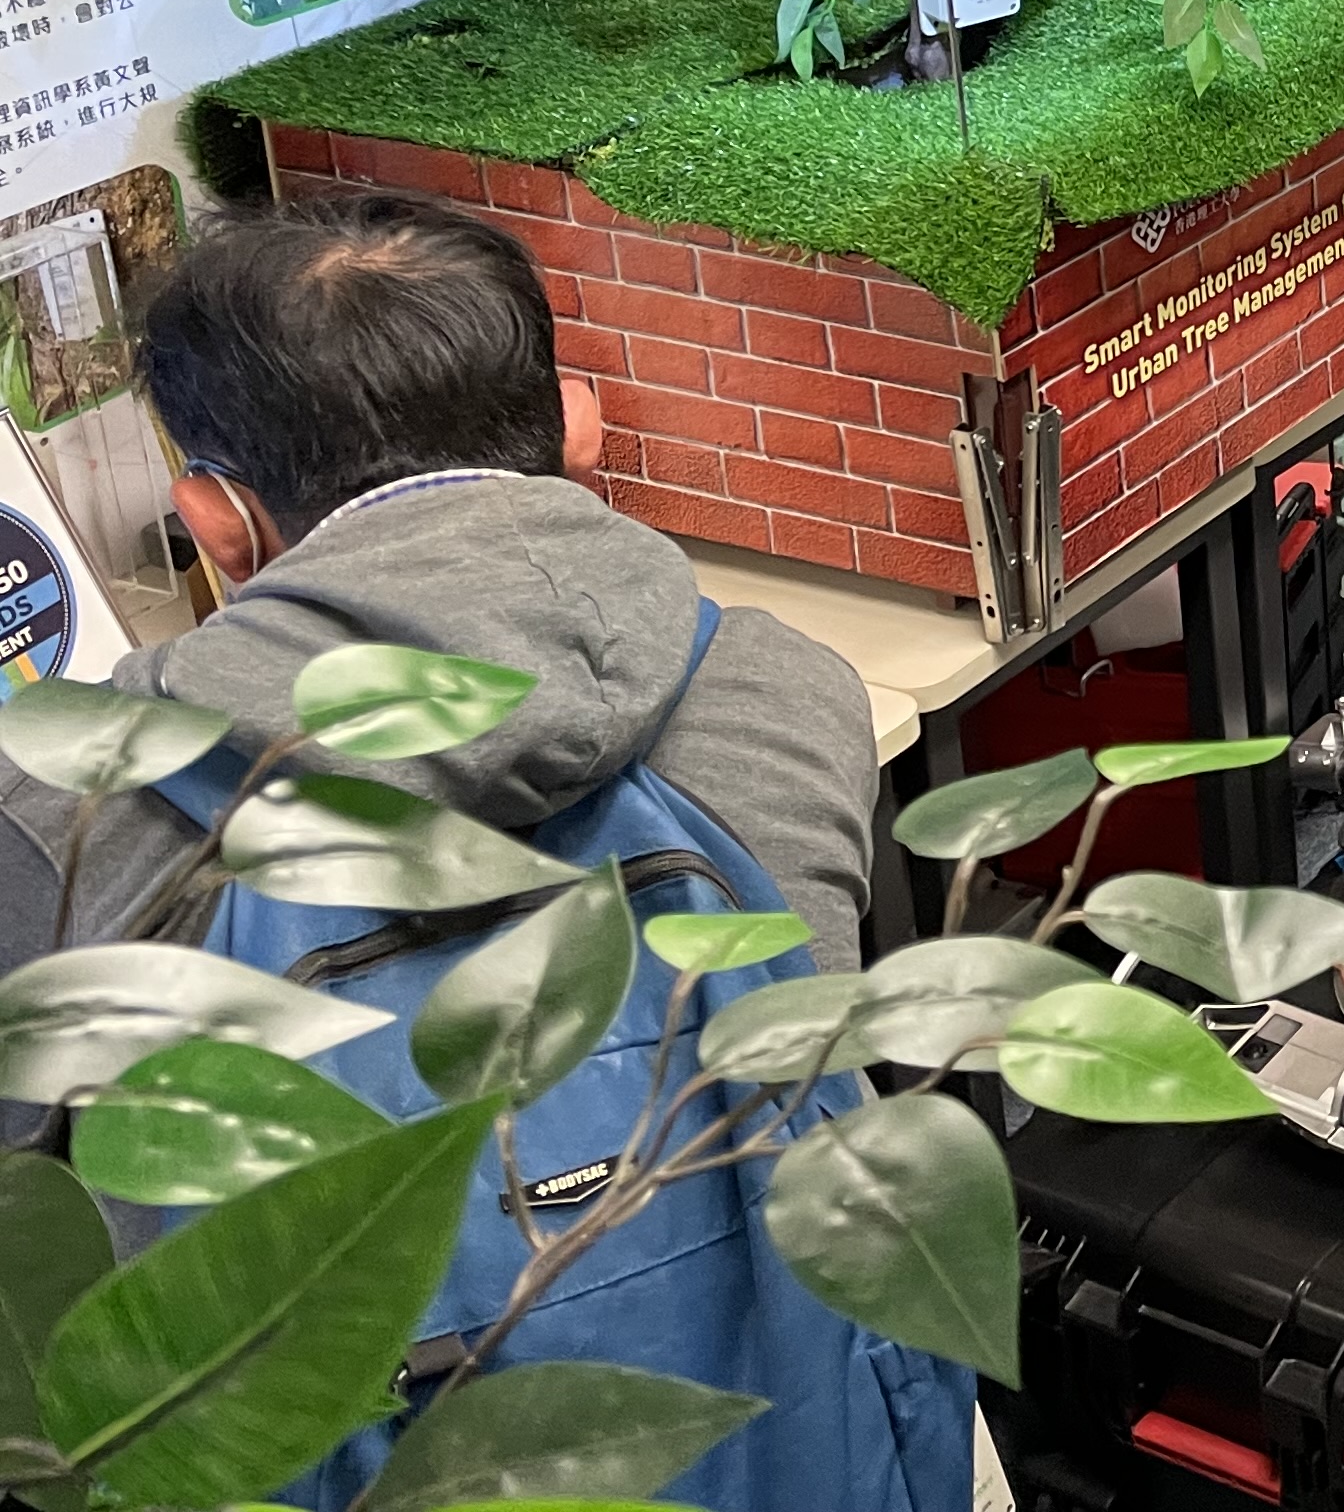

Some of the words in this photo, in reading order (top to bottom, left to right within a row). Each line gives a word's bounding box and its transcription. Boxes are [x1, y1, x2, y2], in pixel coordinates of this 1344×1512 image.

[1083, 315, 1154, 374] Smart
[1156, 245, 1268, 330] Monitoring
[1270, 204, 1339, 260] System
[1111, 342, 1179, 399] Urban
[1181, 311, 1229, 354] Tree
